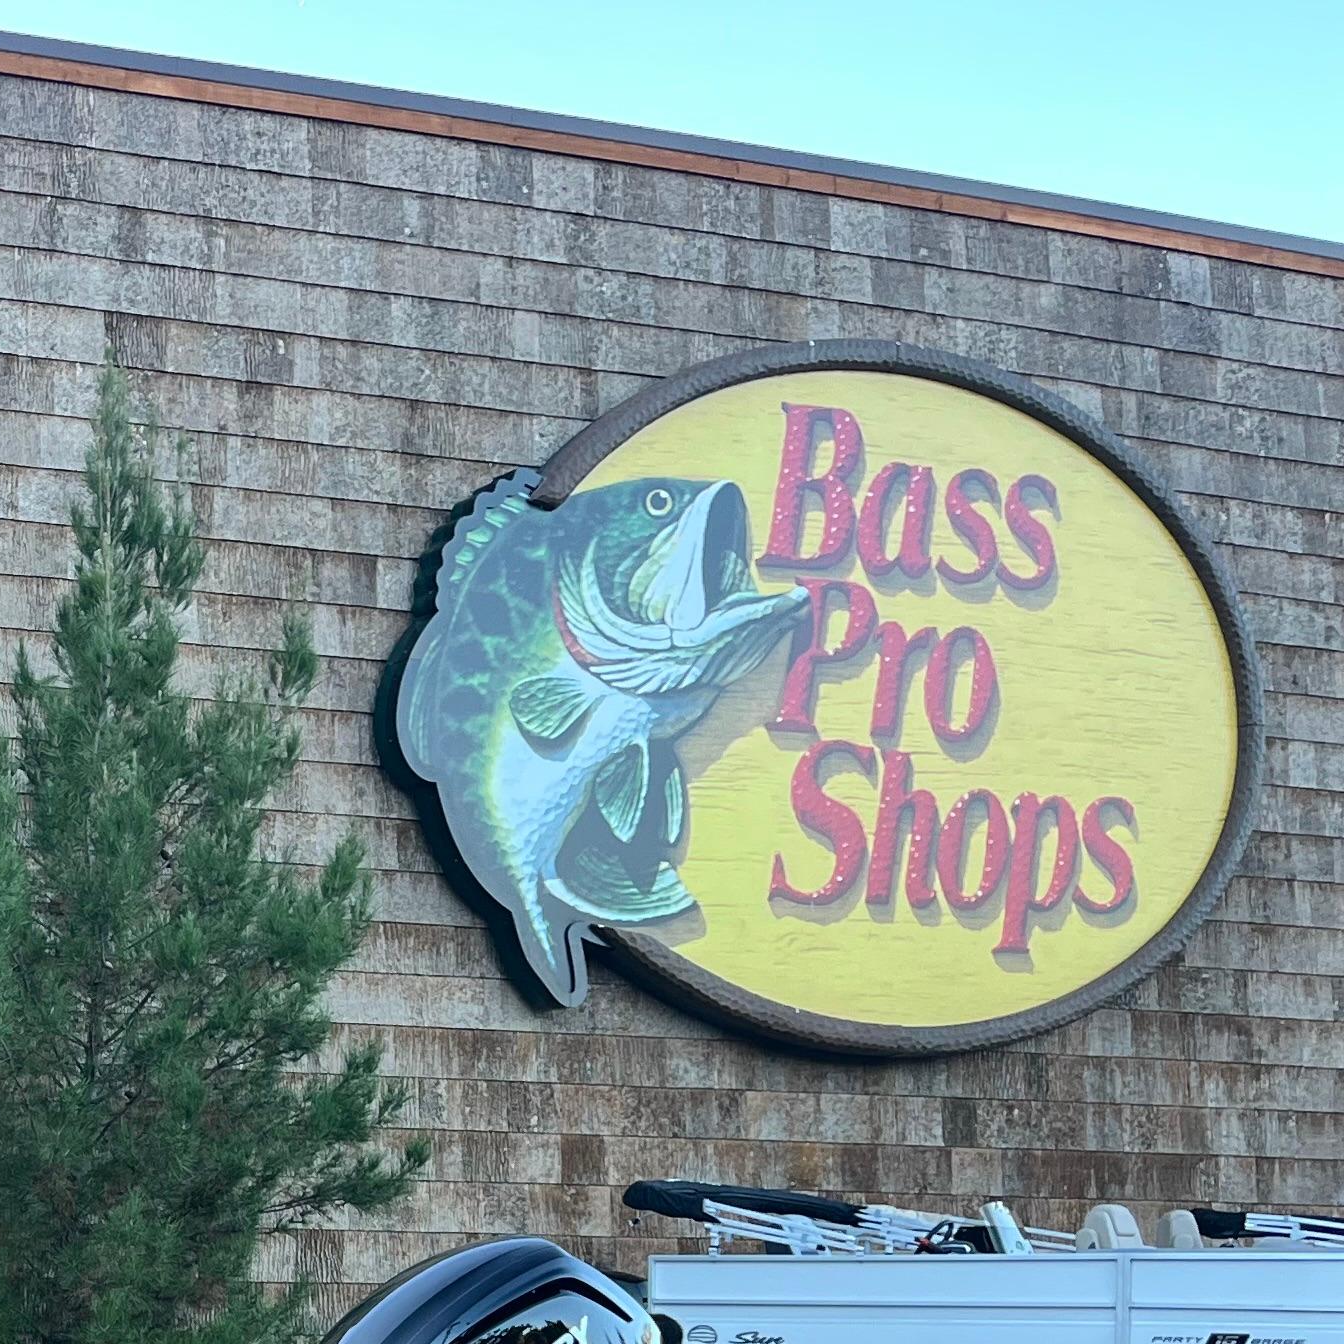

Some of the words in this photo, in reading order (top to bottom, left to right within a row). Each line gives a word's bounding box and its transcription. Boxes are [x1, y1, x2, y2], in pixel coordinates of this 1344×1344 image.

[756, 401, 1059, 590] Bass
[766, 578, 998, 744] Pro
[768, 739, 1138, 955] Shops
[728, 1331, 785, 1344] Sun
[1151, 1336, 1204, 1344] PARTY
